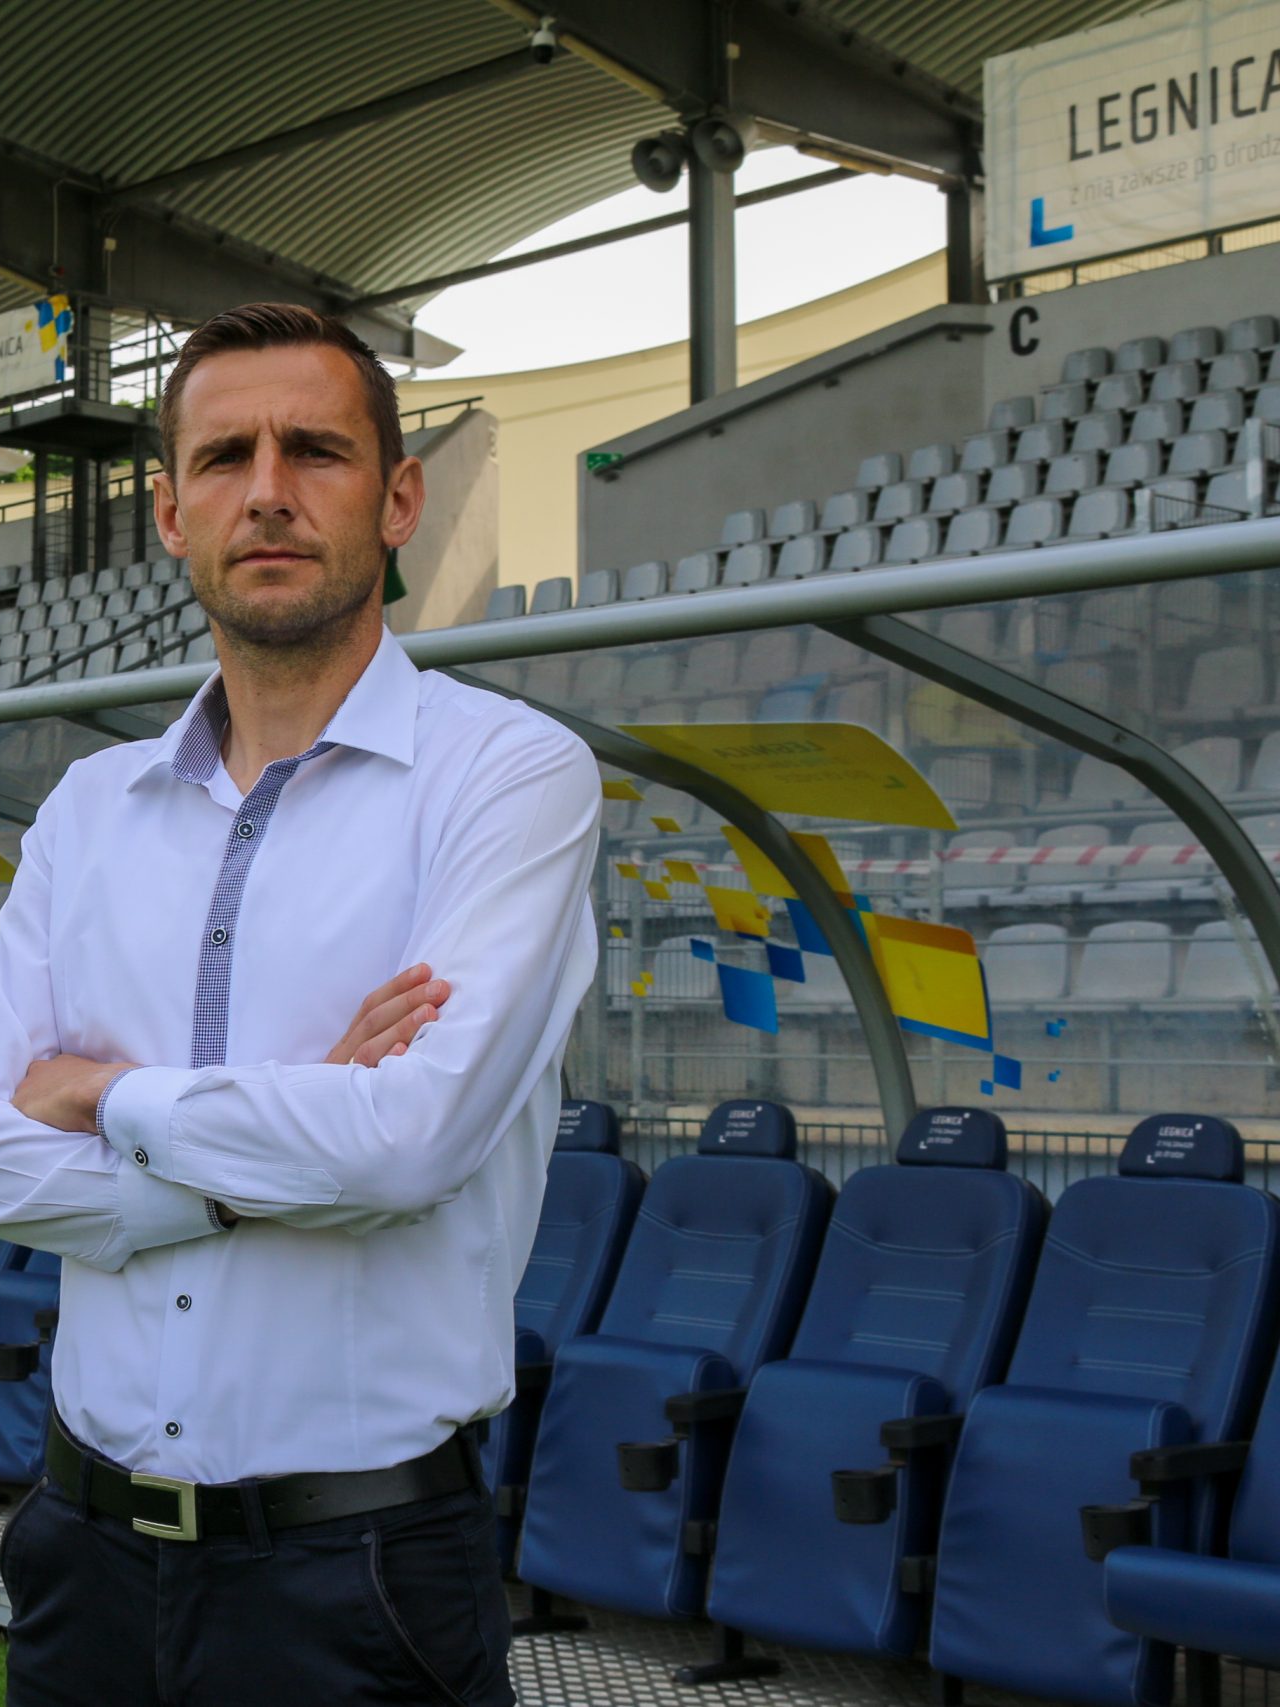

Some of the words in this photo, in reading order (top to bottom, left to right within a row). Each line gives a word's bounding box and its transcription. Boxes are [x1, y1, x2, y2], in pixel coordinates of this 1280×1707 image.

[1068, 48, 1280, 163] LEGNICA
[1120, 160, 1188, 194] zawsze
[1193, 153, 1218, 182] po
[1009, 305, 1040, 356] C
